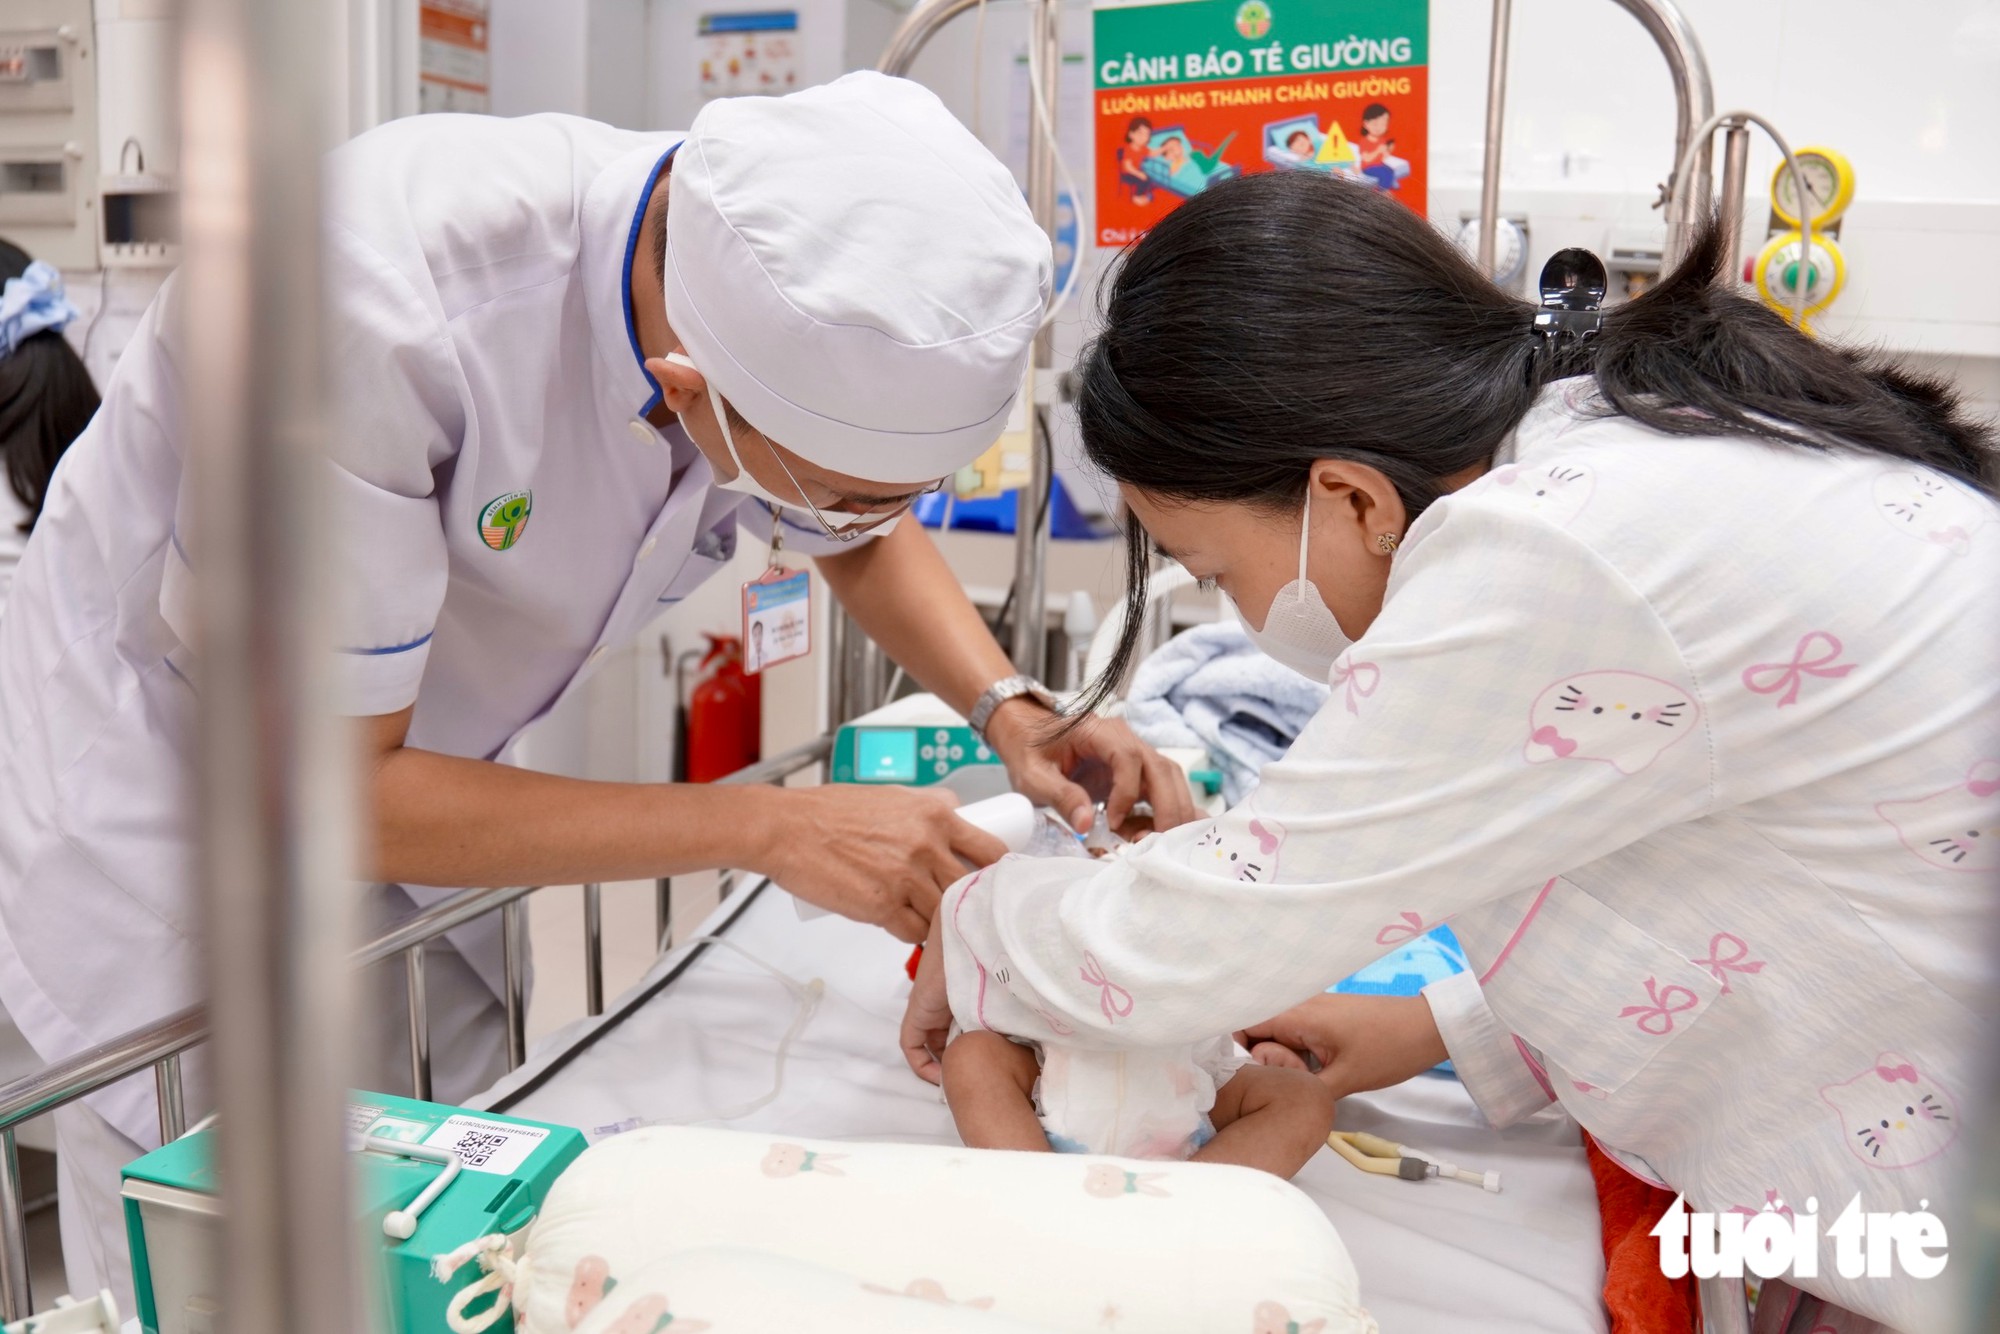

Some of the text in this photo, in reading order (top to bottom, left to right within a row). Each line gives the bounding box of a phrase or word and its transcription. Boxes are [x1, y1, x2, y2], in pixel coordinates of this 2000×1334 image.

[1101, 34, 1412, 84] CẢNH BÁO TÉ GIƯỜNG
[1101, 93, 1150, 115] LUÔN
[1209, 87, 1272, 107] THANH
[1332, 75, 1411, 99] GIƯỜNG
